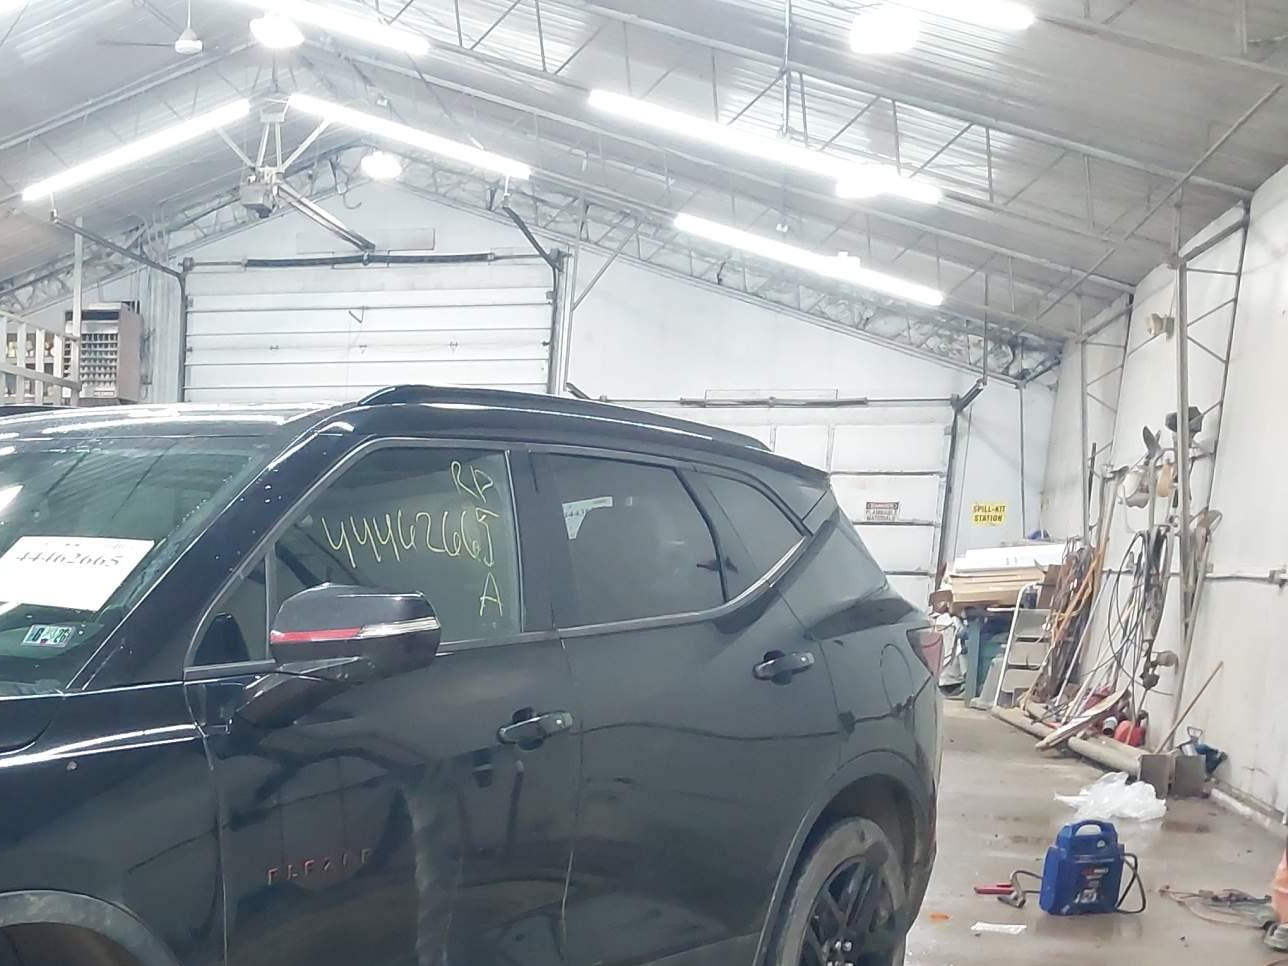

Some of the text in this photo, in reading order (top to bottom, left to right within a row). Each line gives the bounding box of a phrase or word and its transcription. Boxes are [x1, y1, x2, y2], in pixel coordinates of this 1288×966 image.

[973, 504, 1006, 513] SPILL-KIT
[973, 514, 1003, 522] STATION
[321, 507, 501, 568] 44462665
[16, 551, 124, 568] 44462665
[479, 572, 504, 617] A
